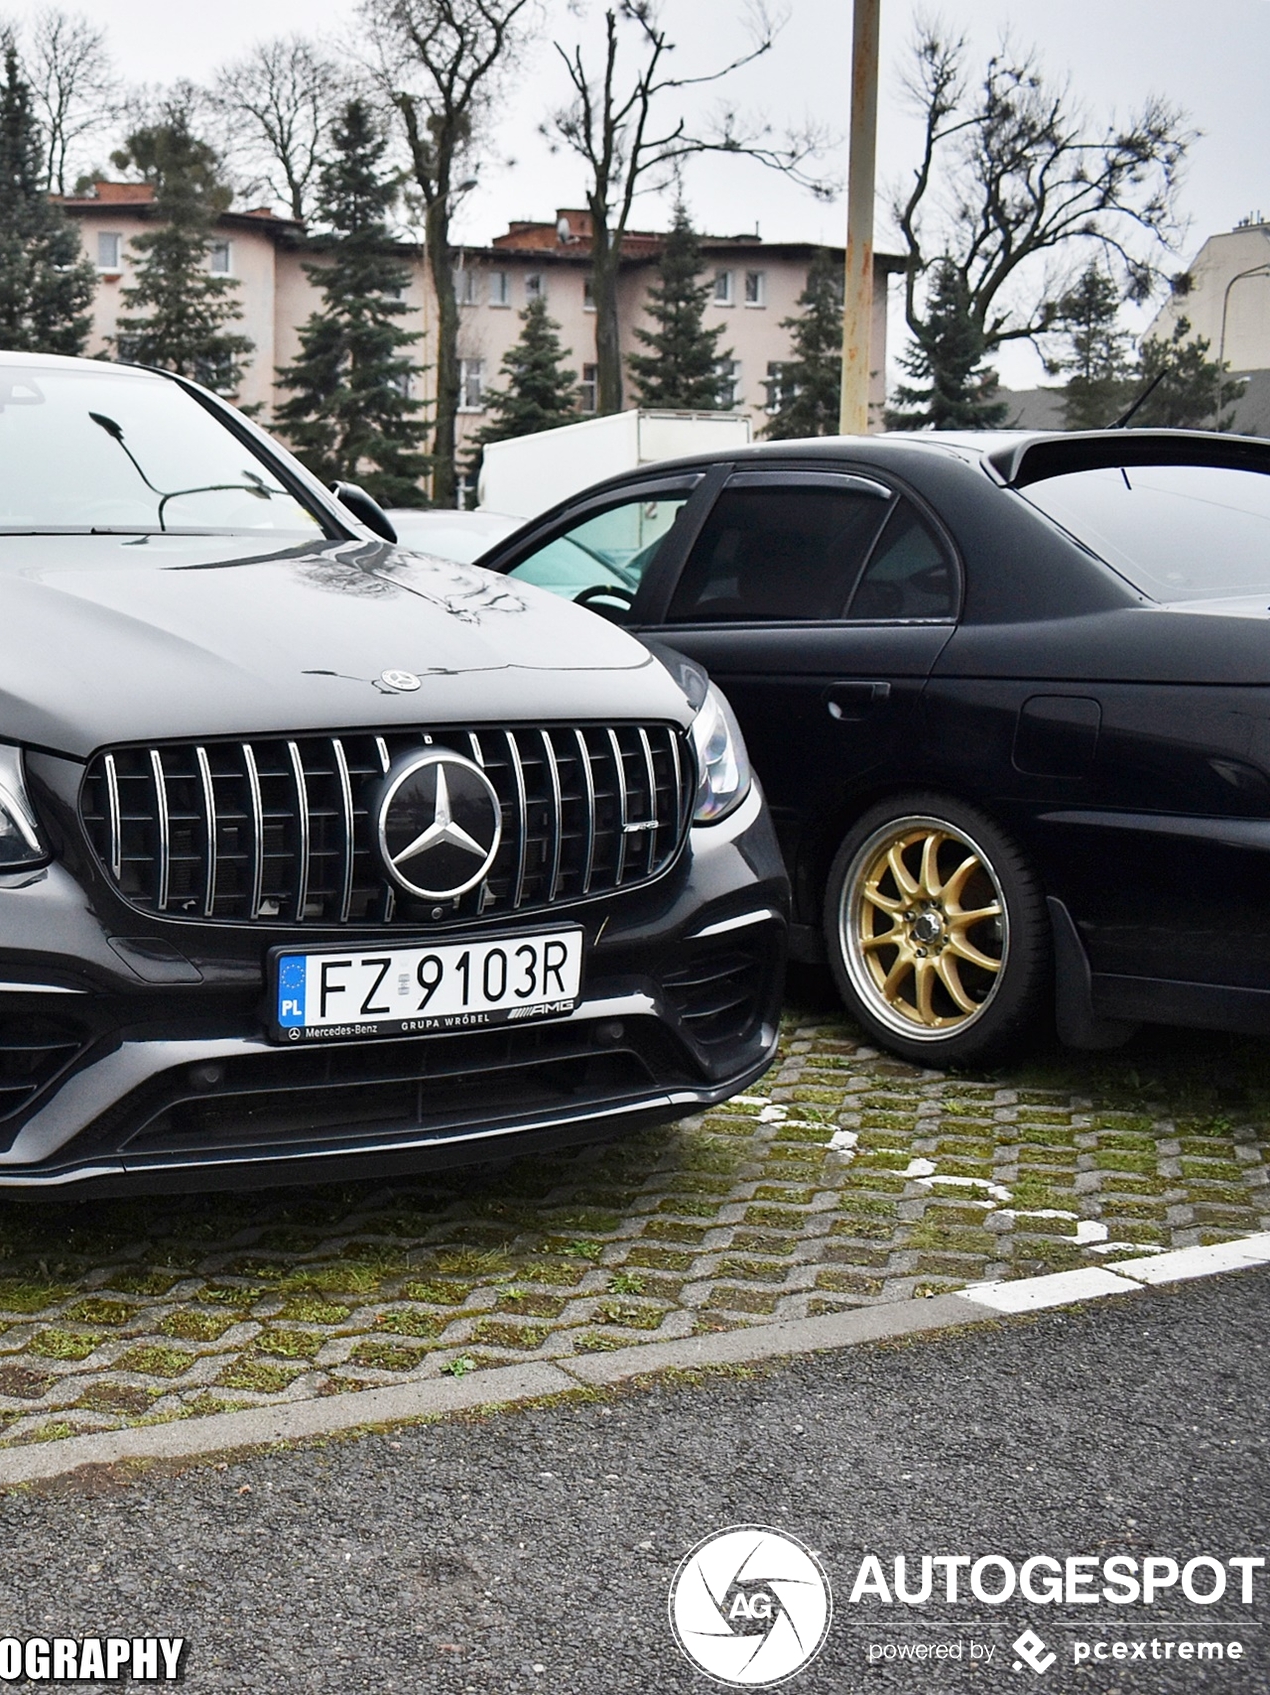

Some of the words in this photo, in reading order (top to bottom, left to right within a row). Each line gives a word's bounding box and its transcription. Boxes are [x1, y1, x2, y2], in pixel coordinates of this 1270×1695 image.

[320, 958, 392, 1018] FZ
[416, 941, 569, 1011] 9103R
[282, 1000, 302, 1016] PL
[530, 1000, 574, 1016] AMG
[401, 1020, 440, 1031] GRUPA
[445, 1014, 490, 1026] WRÓBEL
[306, 1025, 378, 1037] Mercedes-Benz
